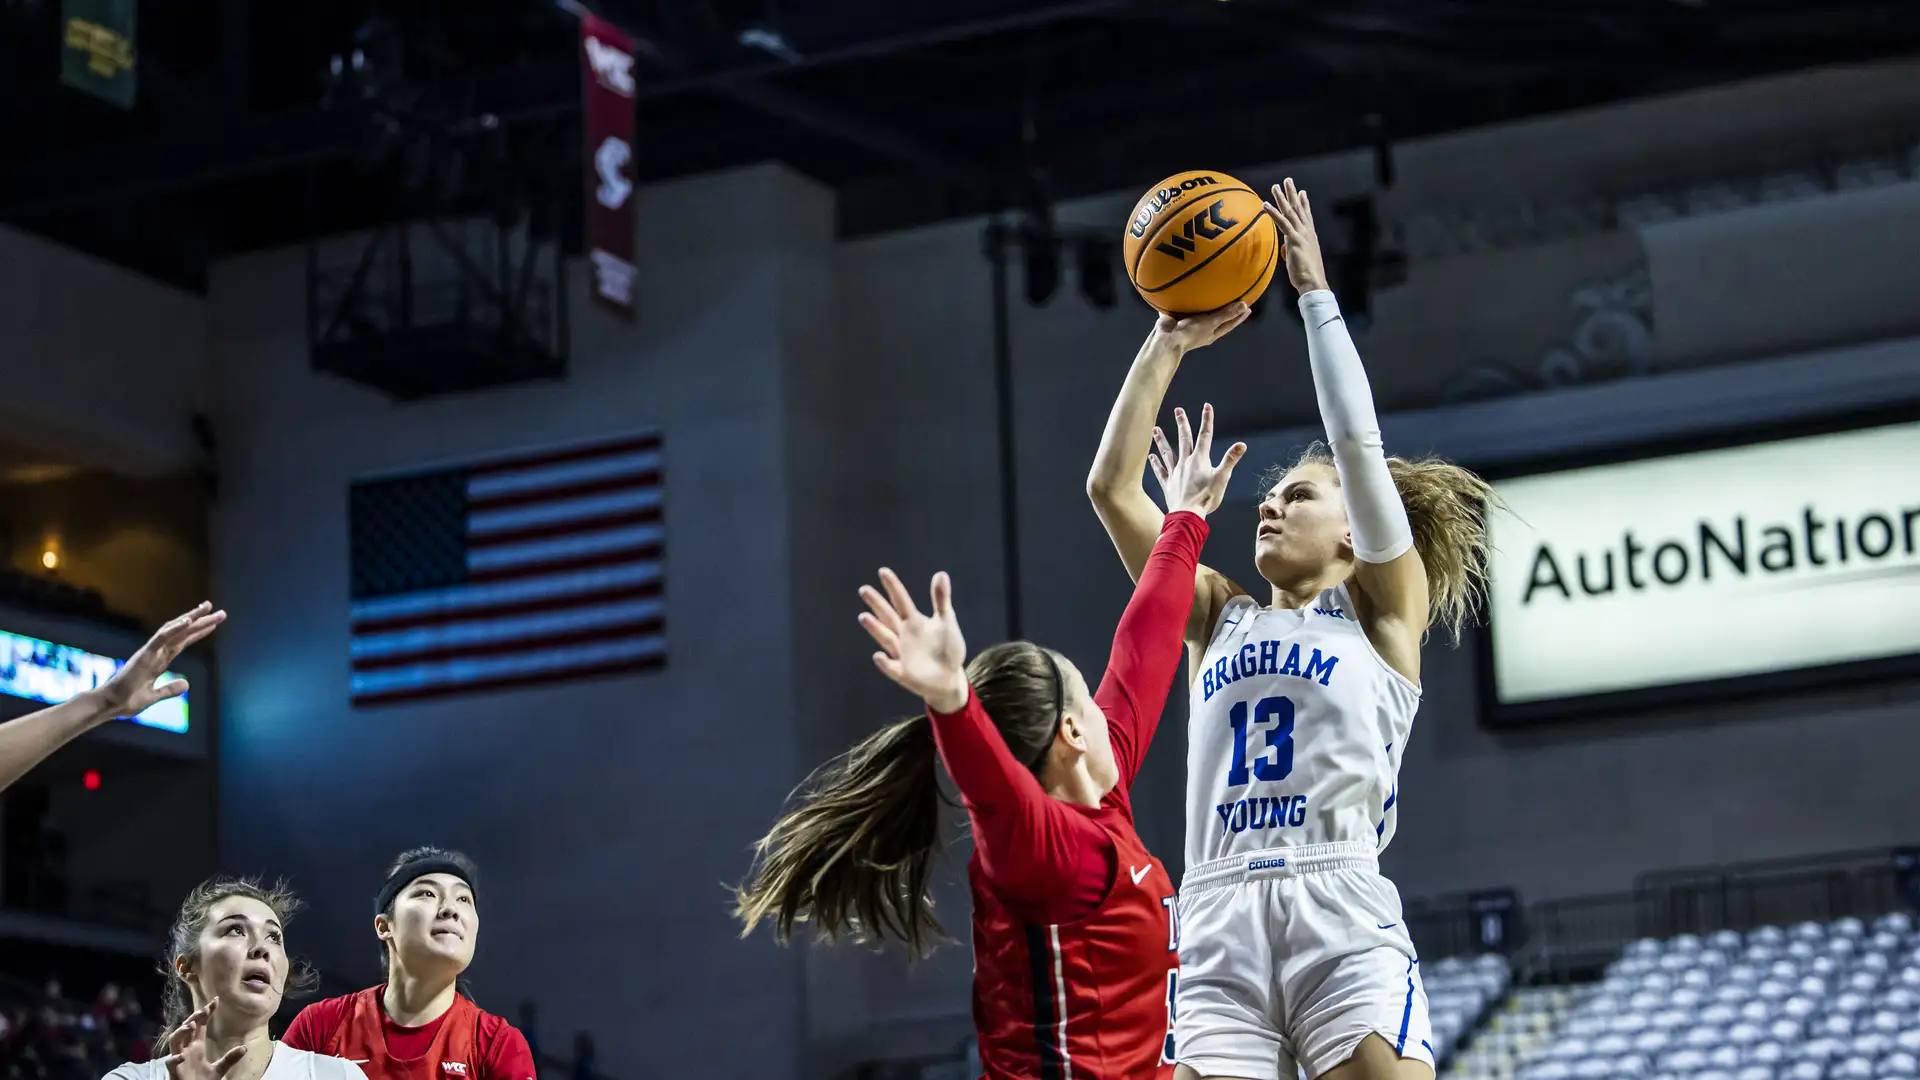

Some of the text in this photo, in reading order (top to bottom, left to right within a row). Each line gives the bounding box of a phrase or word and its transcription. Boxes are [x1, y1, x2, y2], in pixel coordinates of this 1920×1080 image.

[1129, 175, 1218, 240] Wilson
[1154, 199, 1239, 261] WCC
[1202, 640, 1339, 702] BRIGHAM
[1228, 695, 1295, 787] 13
[1216, 794, 1307, 835] YOUNG
[1248, 858, 1285, 871] COUGS
